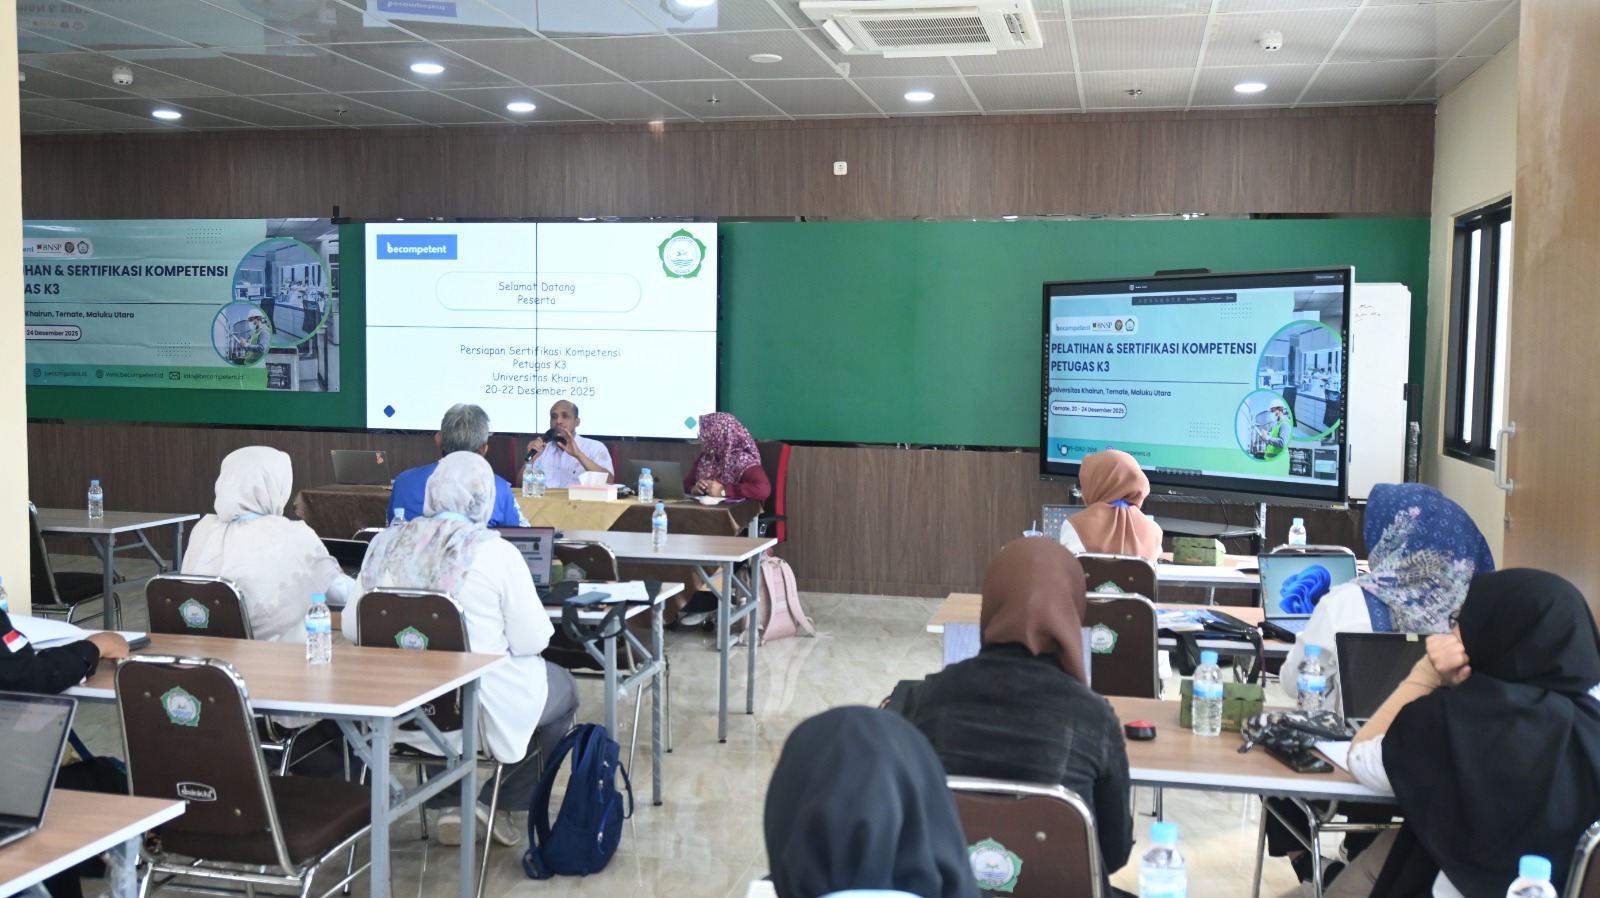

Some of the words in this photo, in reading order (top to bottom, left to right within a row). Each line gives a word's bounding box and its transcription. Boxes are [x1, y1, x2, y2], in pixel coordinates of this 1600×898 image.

[42, 243, 62, 251] BNSP
[386, 241, 447, 256] becompetent
[54, 265, 64, 276] &
[67, 265, 142, 277] SERTIFIKASI
[145, 265, 228, 277] KOMPETENSI
[44, 283, 60, 295] K3
[498, 281, 537, 292] Selamat
[541, 281, 576, 295] Datang
[517, 294, 556, 305] Peserta
[56, 310, 85, 319] Ternate,
[1055, 321, 1091, 332] becompetent
[34, 329, 64, 337] Desember
[460, 344, 506, 358] Persiapan
[508, 345, 562, 357] Sertifikasi
[565, 346, 621, 359] Kompetensi
[1051, 342, 1104, 354] PELATIHAN
[1106, 342, 1114, 354] &
[1116, 342, 1179, 355] SERTIFIKASI
[1181, 342, 1257, 355] KOMPETENSI
[512, 358, 551, 371] Petugas
[554, 359, 567, 370] K3
[1051, 360, 1095, 373] PETUGAS
[1096, 361, 1110, 373] K3
[492, 372, 548, 382] Universitas
[551, 373, 588, 383] Khairun
[485, 384, 514, 395] 20-22
[517, 385, 567, 396] Desember
[570, 386, 596, 397] 2025
[1050, 386, 1081, 394] Universitas
[1154, 389, 1172, 397] Utara
